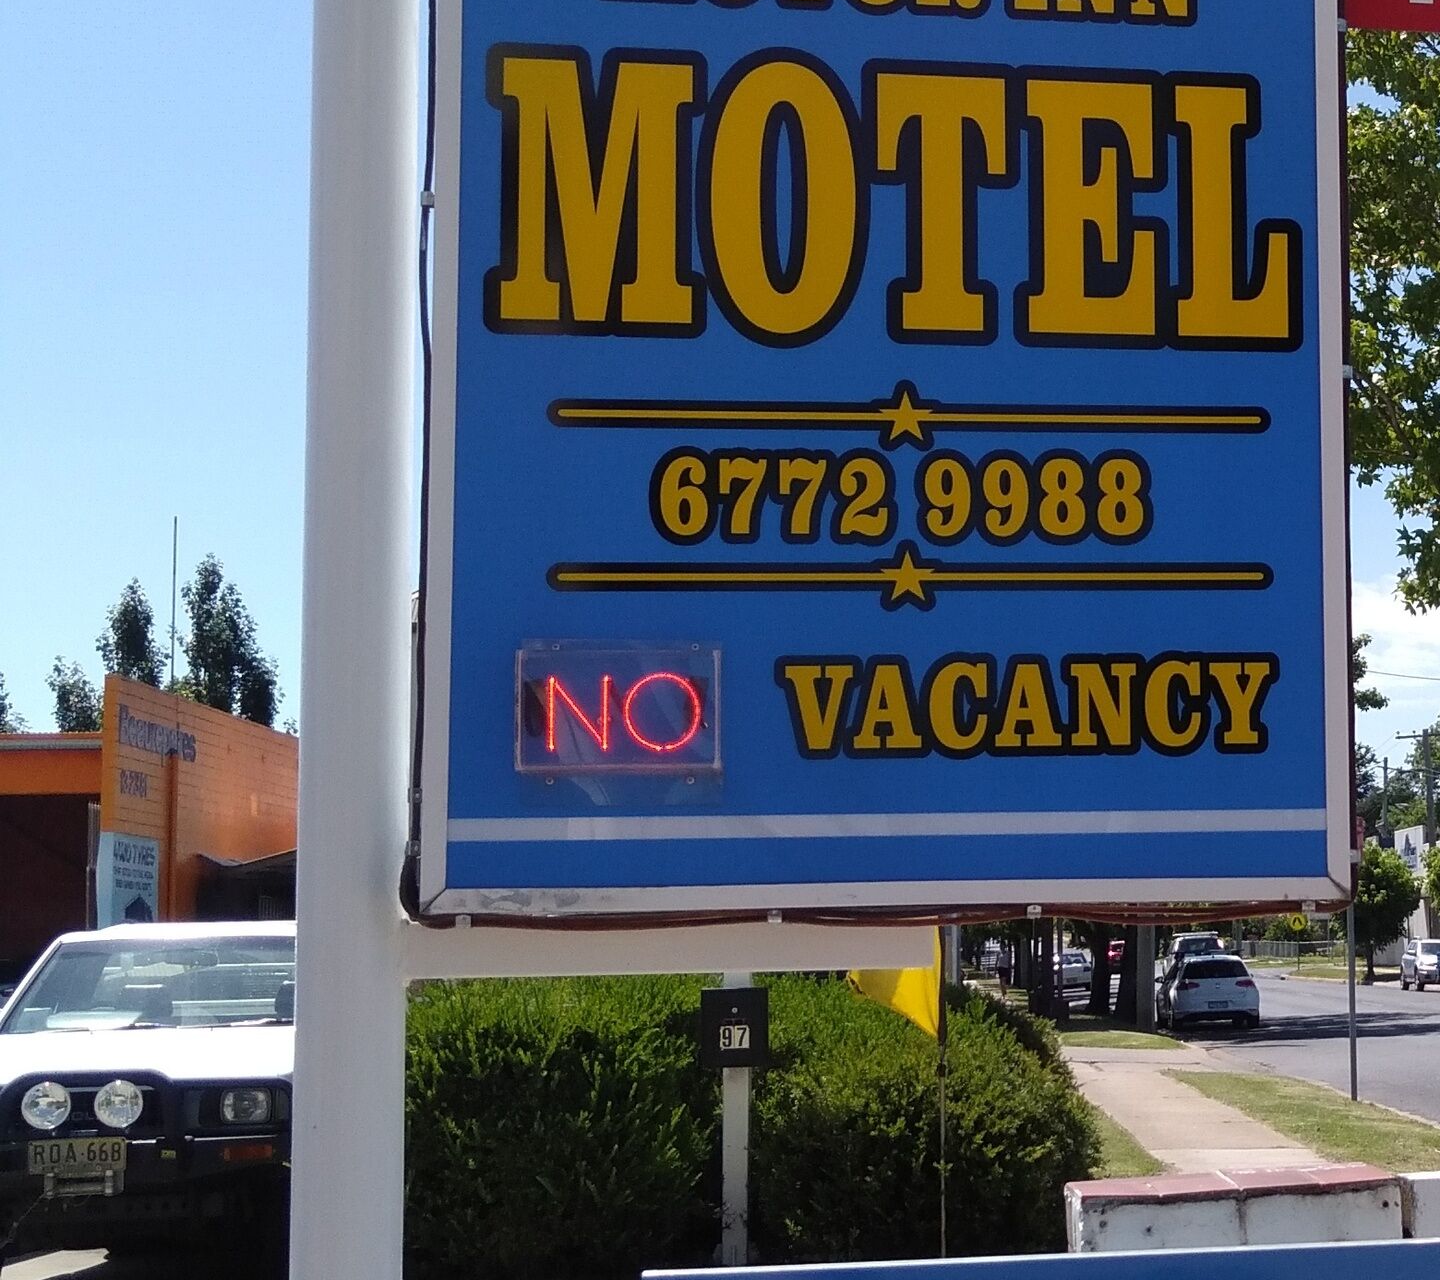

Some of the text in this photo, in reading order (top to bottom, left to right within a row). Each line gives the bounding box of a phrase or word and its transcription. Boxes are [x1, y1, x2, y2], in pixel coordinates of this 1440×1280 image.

[494, 52, 1295, 345] MOTEL
[655, 451, 1148, 541] 6772 9988
[543, 656, 1274, 755] NO VACANCY
[722, 1026, 748, 1048] 97
